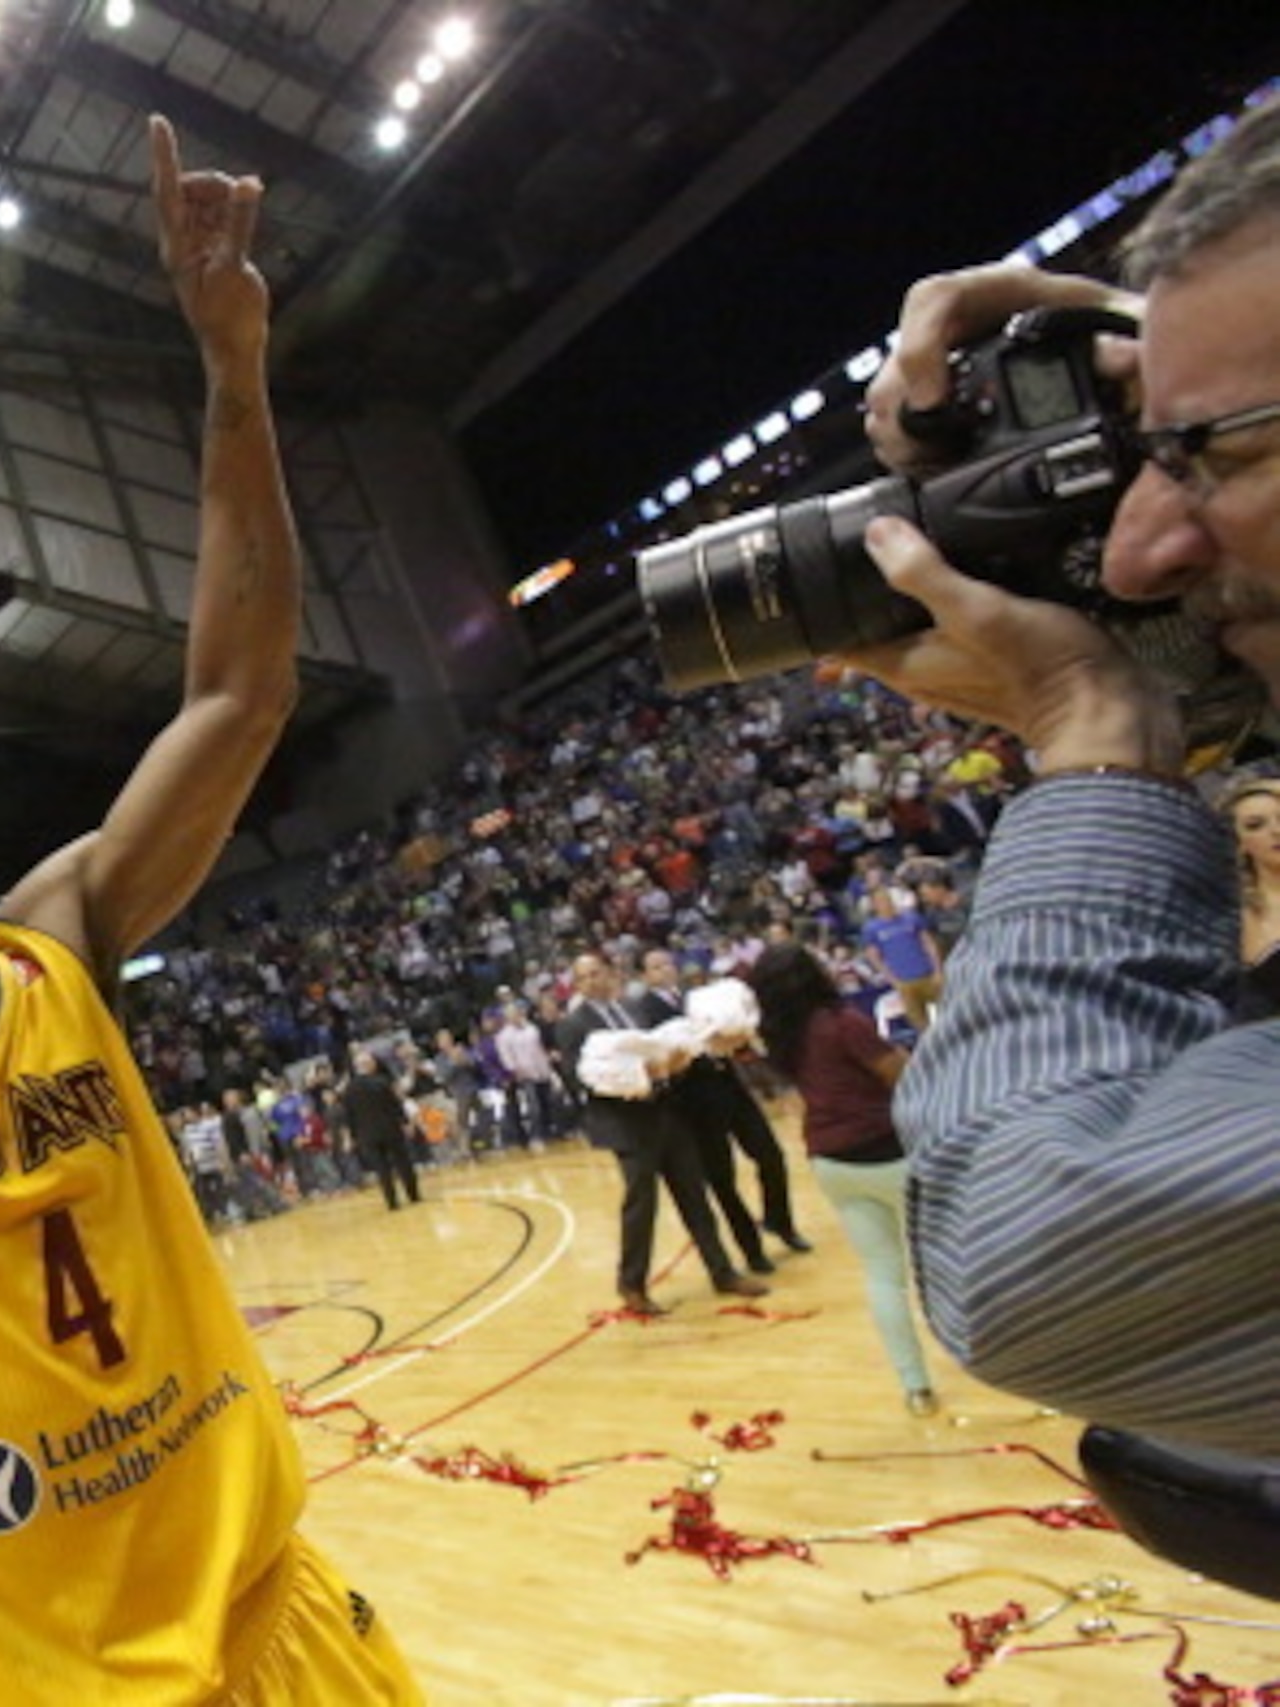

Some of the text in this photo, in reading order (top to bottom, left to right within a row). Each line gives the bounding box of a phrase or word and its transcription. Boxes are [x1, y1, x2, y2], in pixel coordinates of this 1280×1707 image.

[41, 1207, 126, 1371] 4
[38, 1374, 182, 1470] Lutheran
[53, 1371, 250, 1514] Health Network
